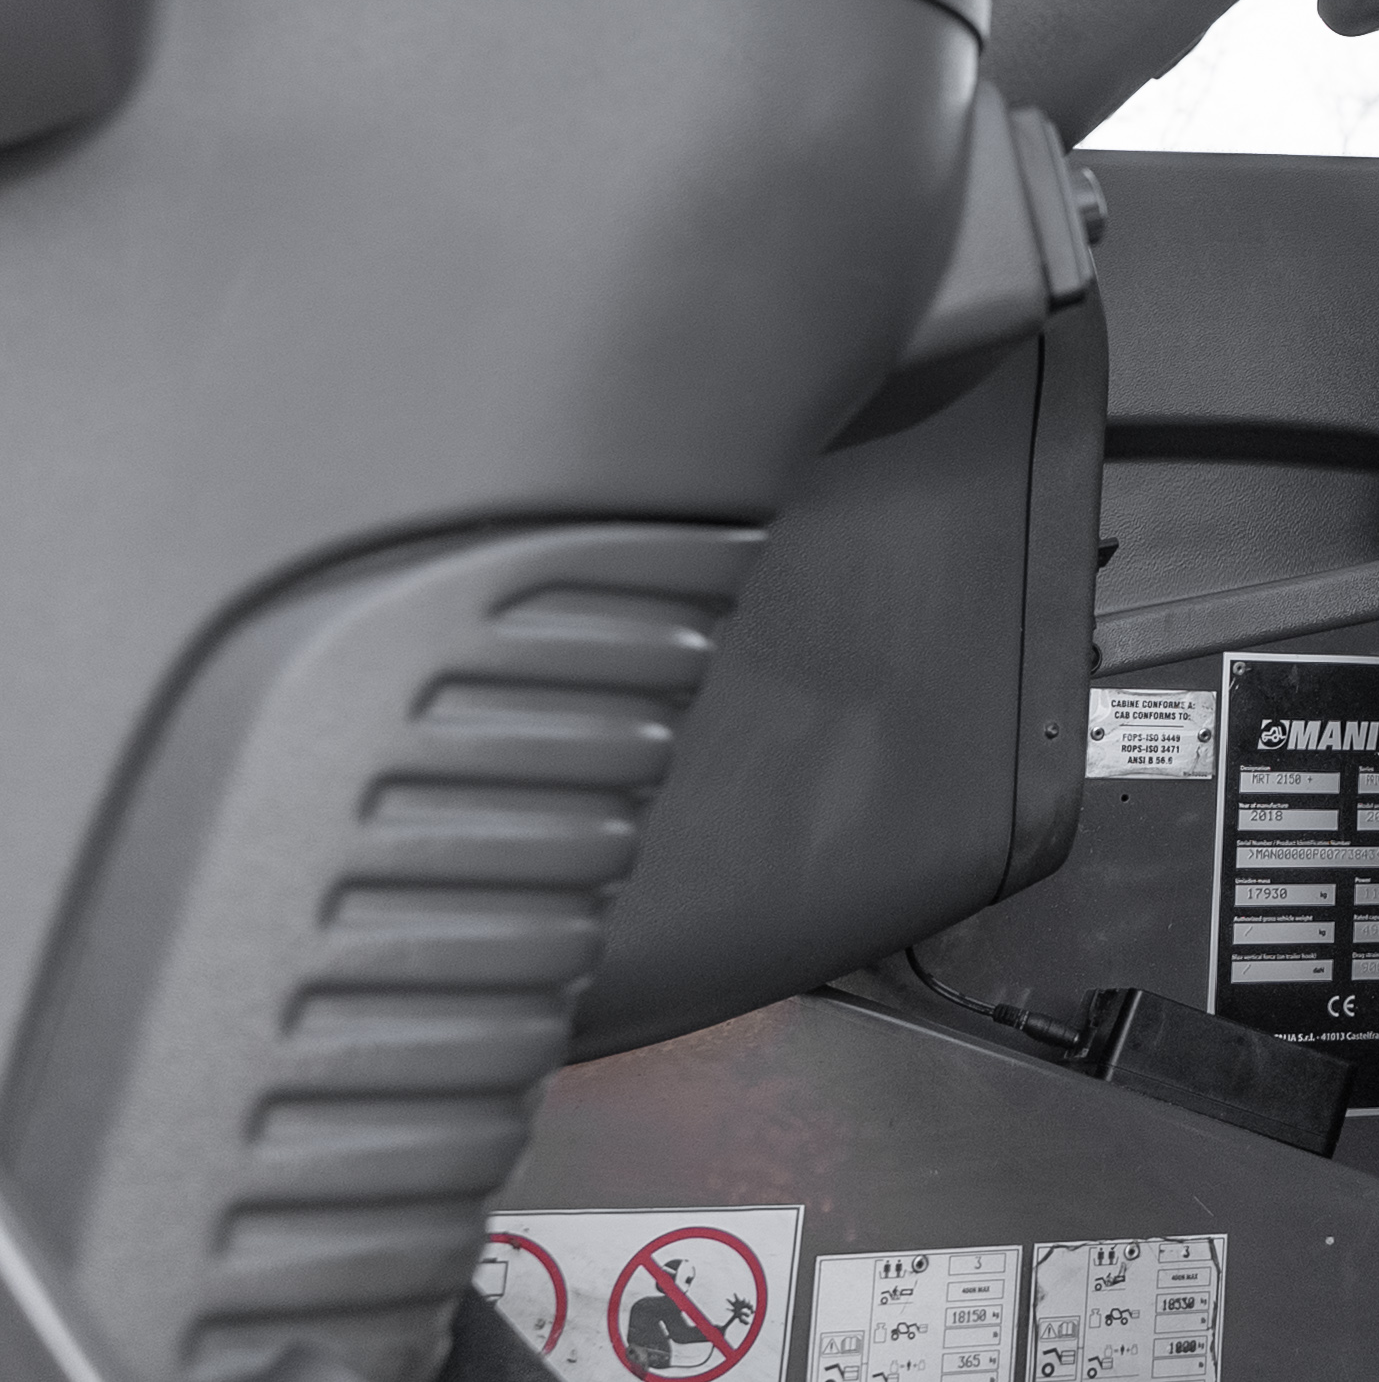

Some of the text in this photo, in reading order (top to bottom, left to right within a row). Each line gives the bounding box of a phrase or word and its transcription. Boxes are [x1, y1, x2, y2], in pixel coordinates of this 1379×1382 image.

[1111, 699, 1140, 708] CABINE
[1142, 700, 1186, 710] CONFORME
[1114, 711, 1192, 721] CAB CONFORMS TO:
[1122, 733, 1181, 743] FOPS-ISO 3449
[1121, 744, 1180, 754] ROPS-ISO 3471
[1127, 756, 1146, 765] ANSI
[1148, 756, 1154, 765] B
[1251, 773, 1270, 785] MRT
[1276, 773, 1302, 785] 2150
[1250, 810, 1283, 822] 2018
[1247, 887, 1288, 900] 17930
[1320, 1032, 1345, 1042] 41013
[1183, 1245, 1190, 1258] 3
[974, 1255, 982, 1270] 3
[952, 1308, 987, 1324] 18150
[957, 1353, 981, 1369] 365
